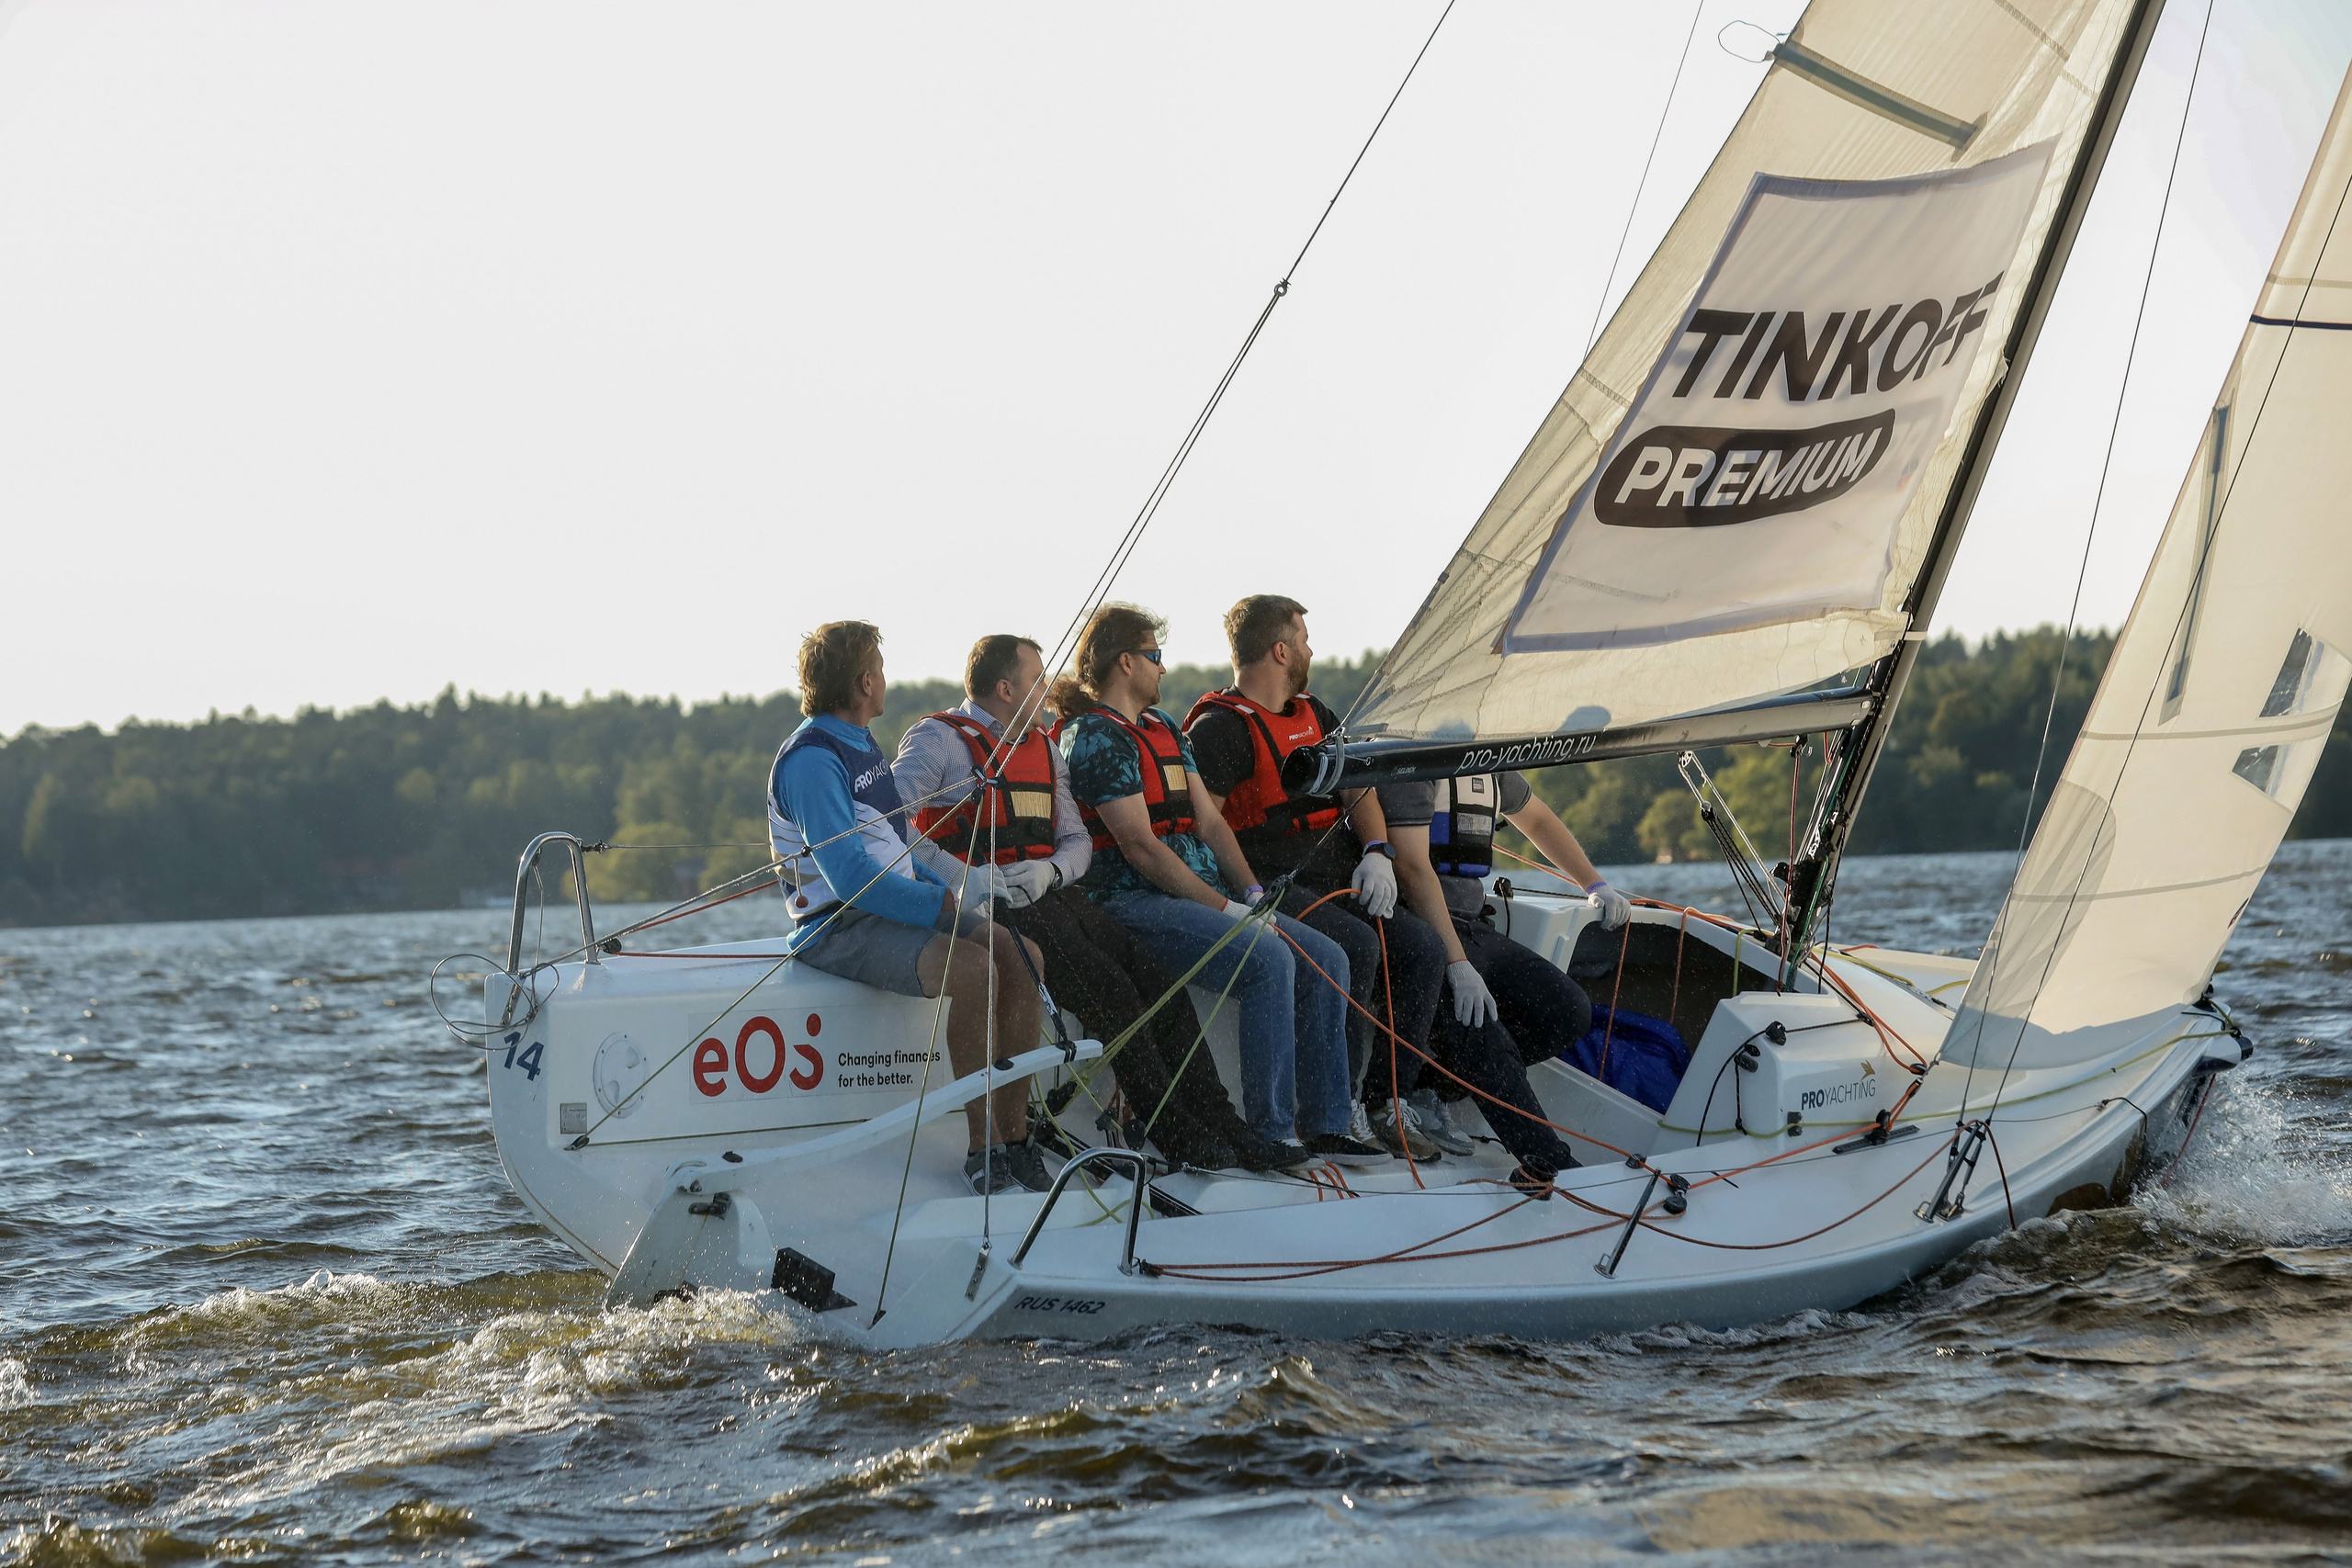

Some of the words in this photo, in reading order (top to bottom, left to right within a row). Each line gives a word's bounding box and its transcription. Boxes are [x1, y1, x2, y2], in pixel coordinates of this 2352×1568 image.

[1672, 269, 2005, 401] TINKOFF
[1614, 427, 1883, 508] PREMIUM
[1453, 735, 1598, 775] pro-yachting.ru
[503, 1031, 544, 1081] 14
[838, 1051, 891, 1068] Changing
[894, 1050, 941, 1064] finances
[838, 1074, 854, 1088] for
[857, 1073, 874, 1086] the
[877, 1072, 913, 1086] better.
[1801, 1078, 1876, 1111] PROYACHTING
[1014, 1296, 1059, 1311] RUS
[1059, 1299, 1106, 1314] 1462
